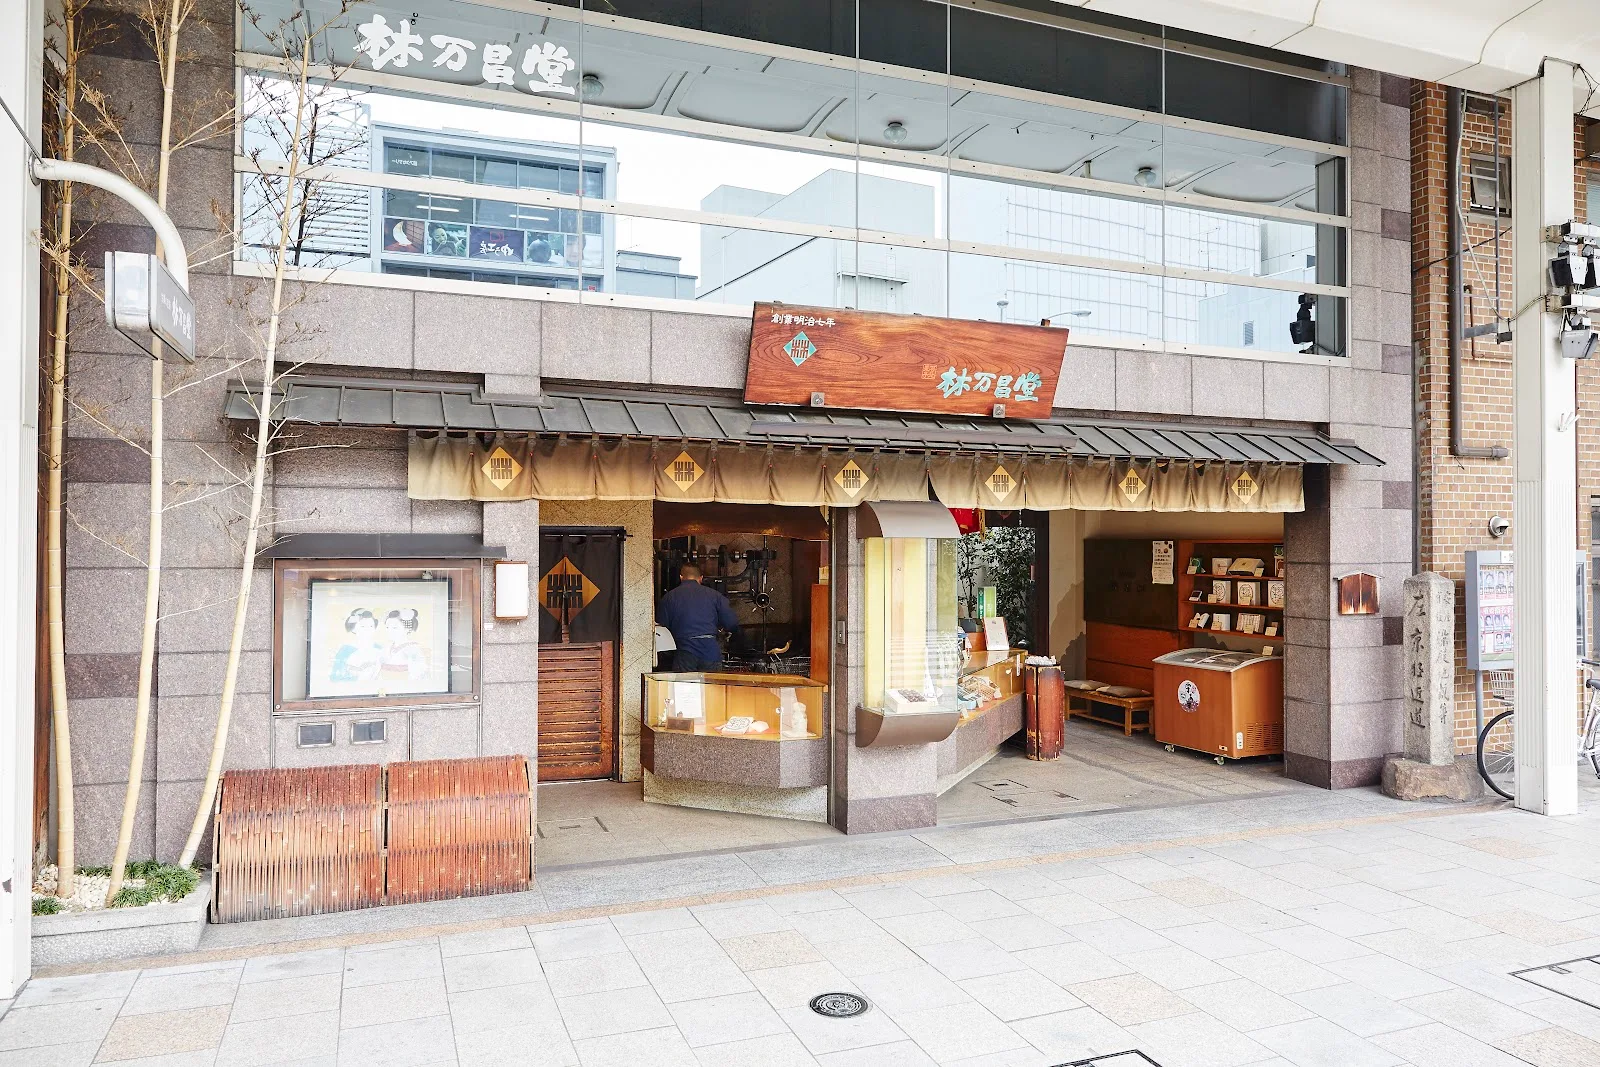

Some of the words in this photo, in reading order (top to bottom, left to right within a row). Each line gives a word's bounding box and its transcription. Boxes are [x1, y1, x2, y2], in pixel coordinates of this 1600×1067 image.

[353, 14, 575, 95] 林万昌堂
[771, 313, 836, 328] 創業明治七年
[936, 366, 1042, 402] 林万昌堂
